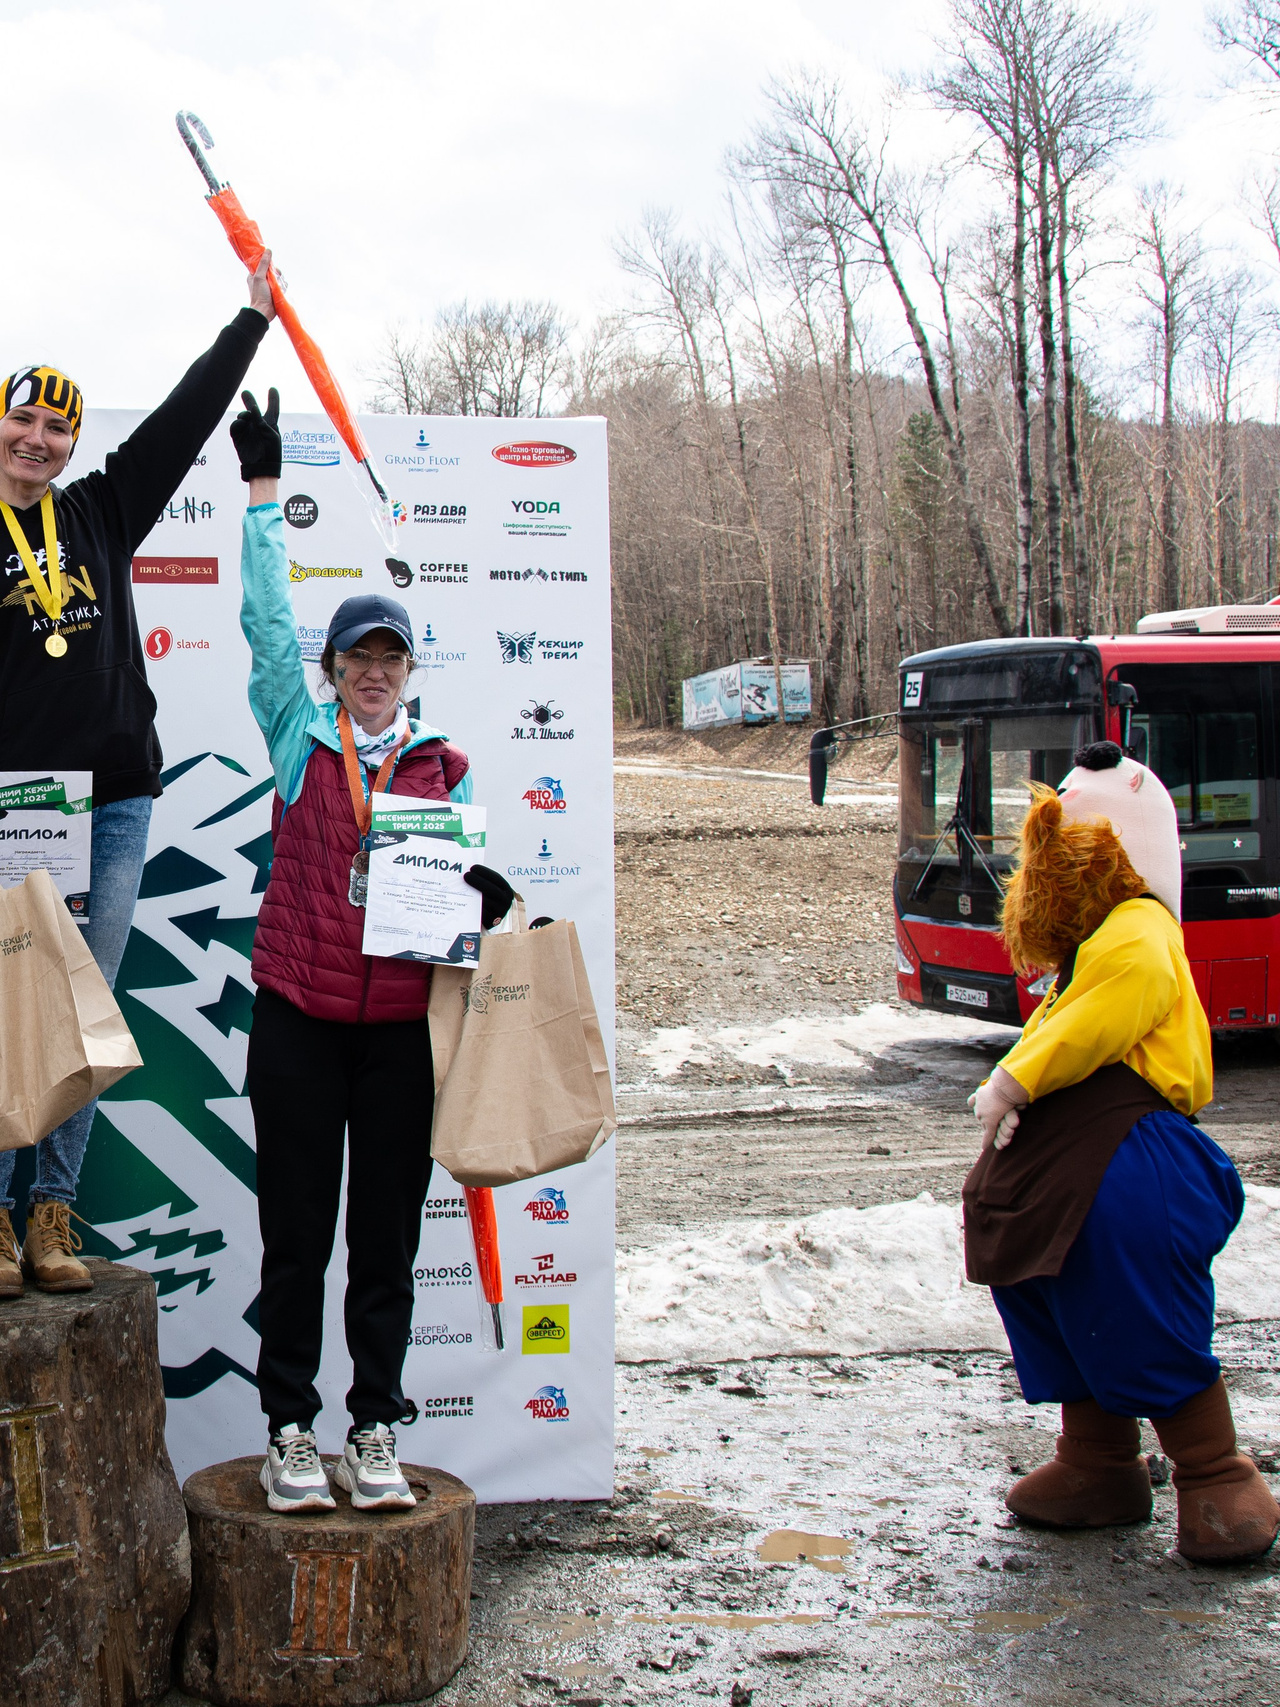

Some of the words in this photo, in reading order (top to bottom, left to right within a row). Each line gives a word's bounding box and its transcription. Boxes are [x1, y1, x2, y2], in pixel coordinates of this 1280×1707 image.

[385, 454, 425, 466] GRAND
[429, 456, 460, 466] FLOAT
[499, 454, 520, 462] центр
[156, 496, 213, 524] LNA
[288, 503, 314, 515] VAF
[414, 504, 437, 516] РАЗ
[439, 505, 467, 517] ДВА
[511, 500, 561, 514] YODA
[289, 514, 314, 522] sport
[139, 566, 163, 574] ПЯТЬ
[184, 566, 213, 575] ЗВЕЗД
[306, 568, 363, 579] ПОДВОРЬЕ
[420, 563, 469, 573] COFFEE
[420, 574, 469, 583] REPUBLIC
[297, 626, 328, 639] ЙСБЕ
[176, 639, 210, 649] slavda
[538, 640, 584, 649] ХЕХЦИР
[436, 652, 467, 661] FLOAT
[906, 681, 920, 698] 25
[24, 783, 63, 794] ХЕХЦИР
[23, 794, 47, 803] 2025
[521, 790, 551, 801] АВТО
[530, 800, 567, 810] РАДИО
[375, 814, 422, 822] ВЕСЕННИЙ
[424, 814, 460, 822] ХЕХЦИР
[423, 822, 445, 830] 2025
[392, 853, 462, 873] ДИПЛОМ
[507, 866, 547, 876] GRAND
[550, 866, 581, 876] FLOAT
[490, 984, 530, 994] ХЕХЦИР
[425, 1198, 465, 1209] COFFE
[523, 1201, 554, 1213] АВТО
[425, 1211, 468, 1219] REPUBLI
[532, 1210, 569, 1221] РАДИО
[515, 1272, 577, 1285] FLYHAB
[414, 1324, 449, 1334] СЕРГЕЙ
[530, 1329, 561, 1337] ЭВЕРЕСТ
[415, 1333, 473, 1346] БОРОХОВ
[425, 1396, 474, 1407] COFFEE
[524, 1399, 554, 1410] АВТО
[425, 1408, 474, 1419] REPUBLIC
[532, 1408, 569, 1419] РАДИО
